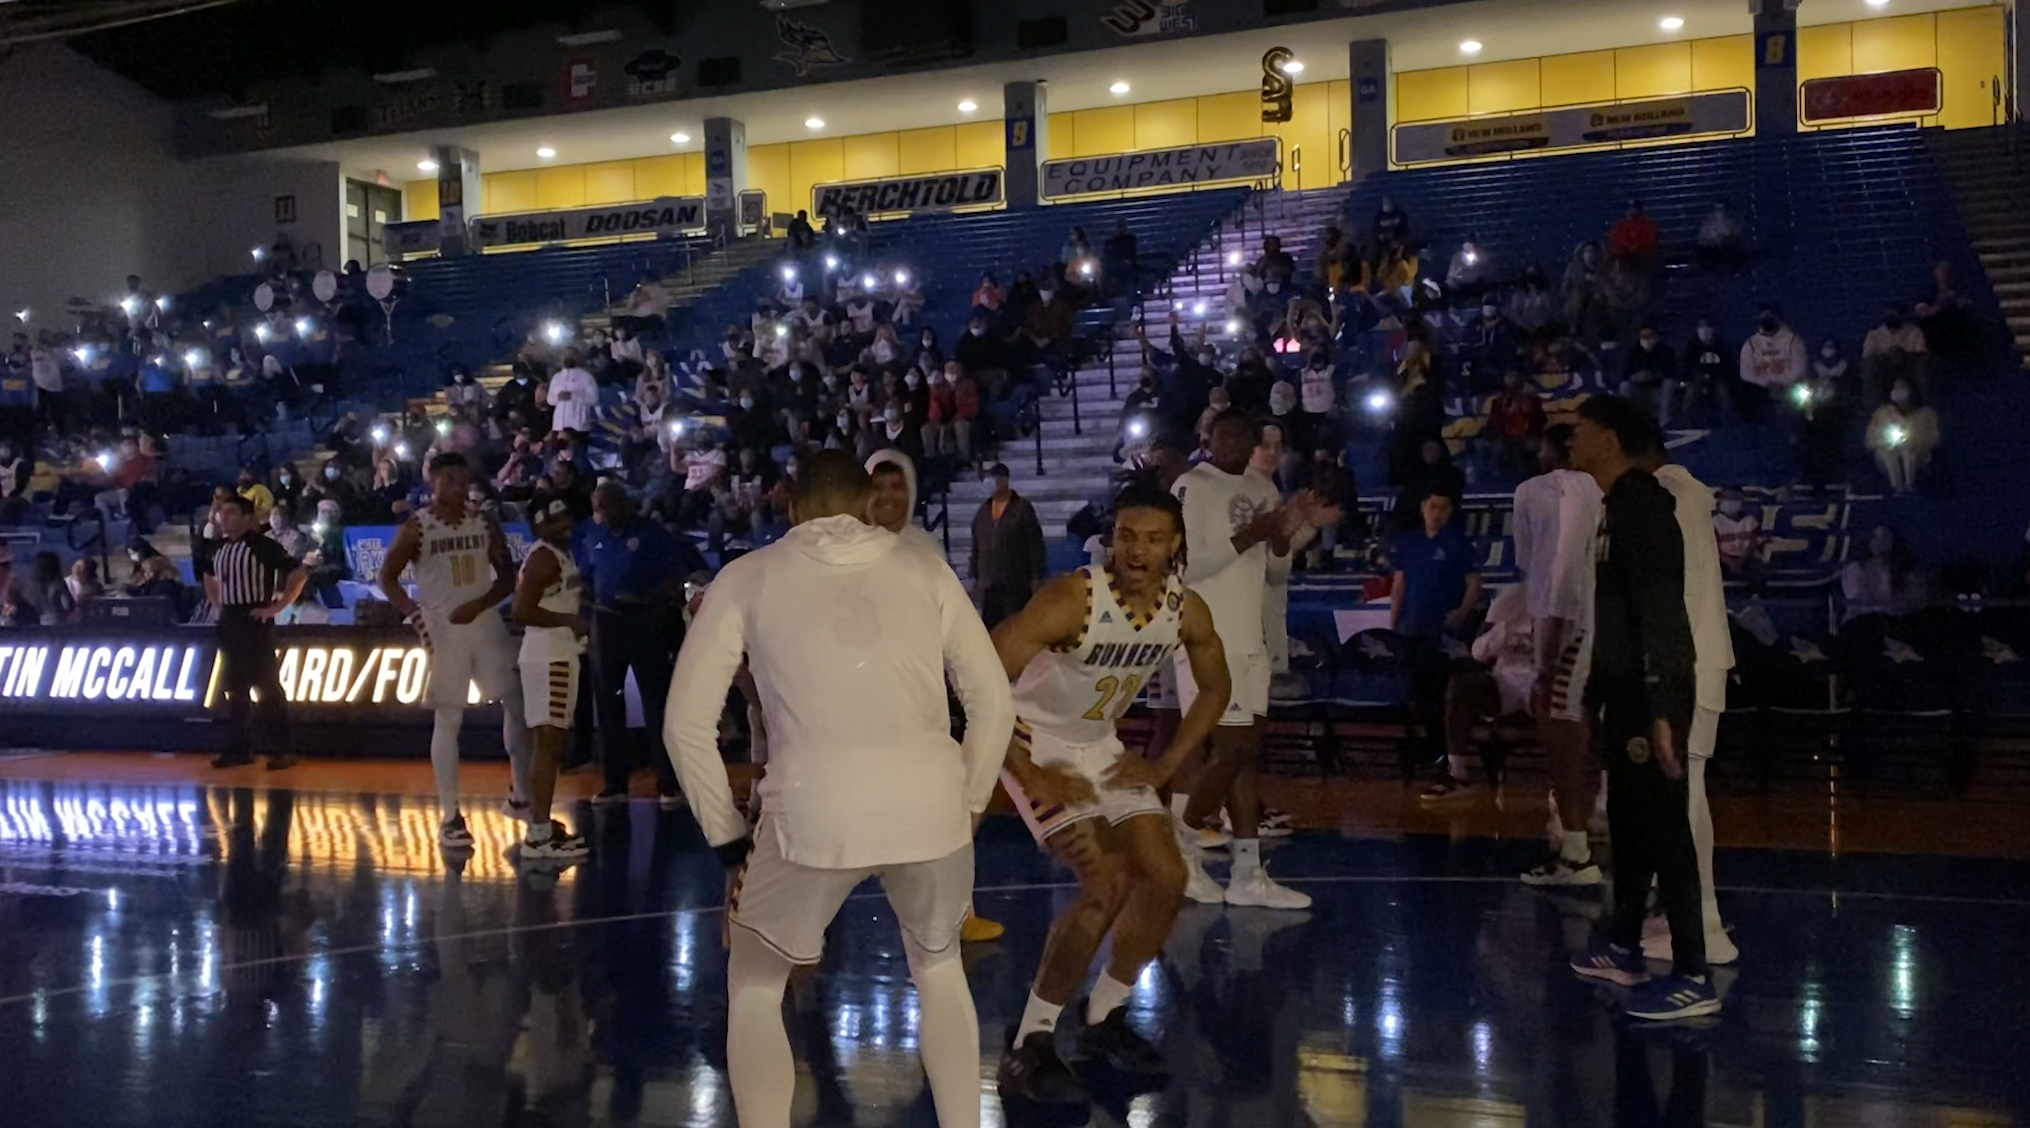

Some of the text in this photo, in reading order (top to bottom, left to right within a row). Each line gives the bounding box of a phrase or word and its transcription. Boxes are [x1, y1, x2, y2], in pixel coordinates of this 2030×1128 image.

[1047, 143, 1240, 180] EQUIPMENT
[1064, 164, 1222, 194] COMPANY
[818, 173, 998, 215] BERCHTOLD
[505, 205, 697, 242] Bobcat DOOSAN
[49, 646, 196, 701] MCCALL
